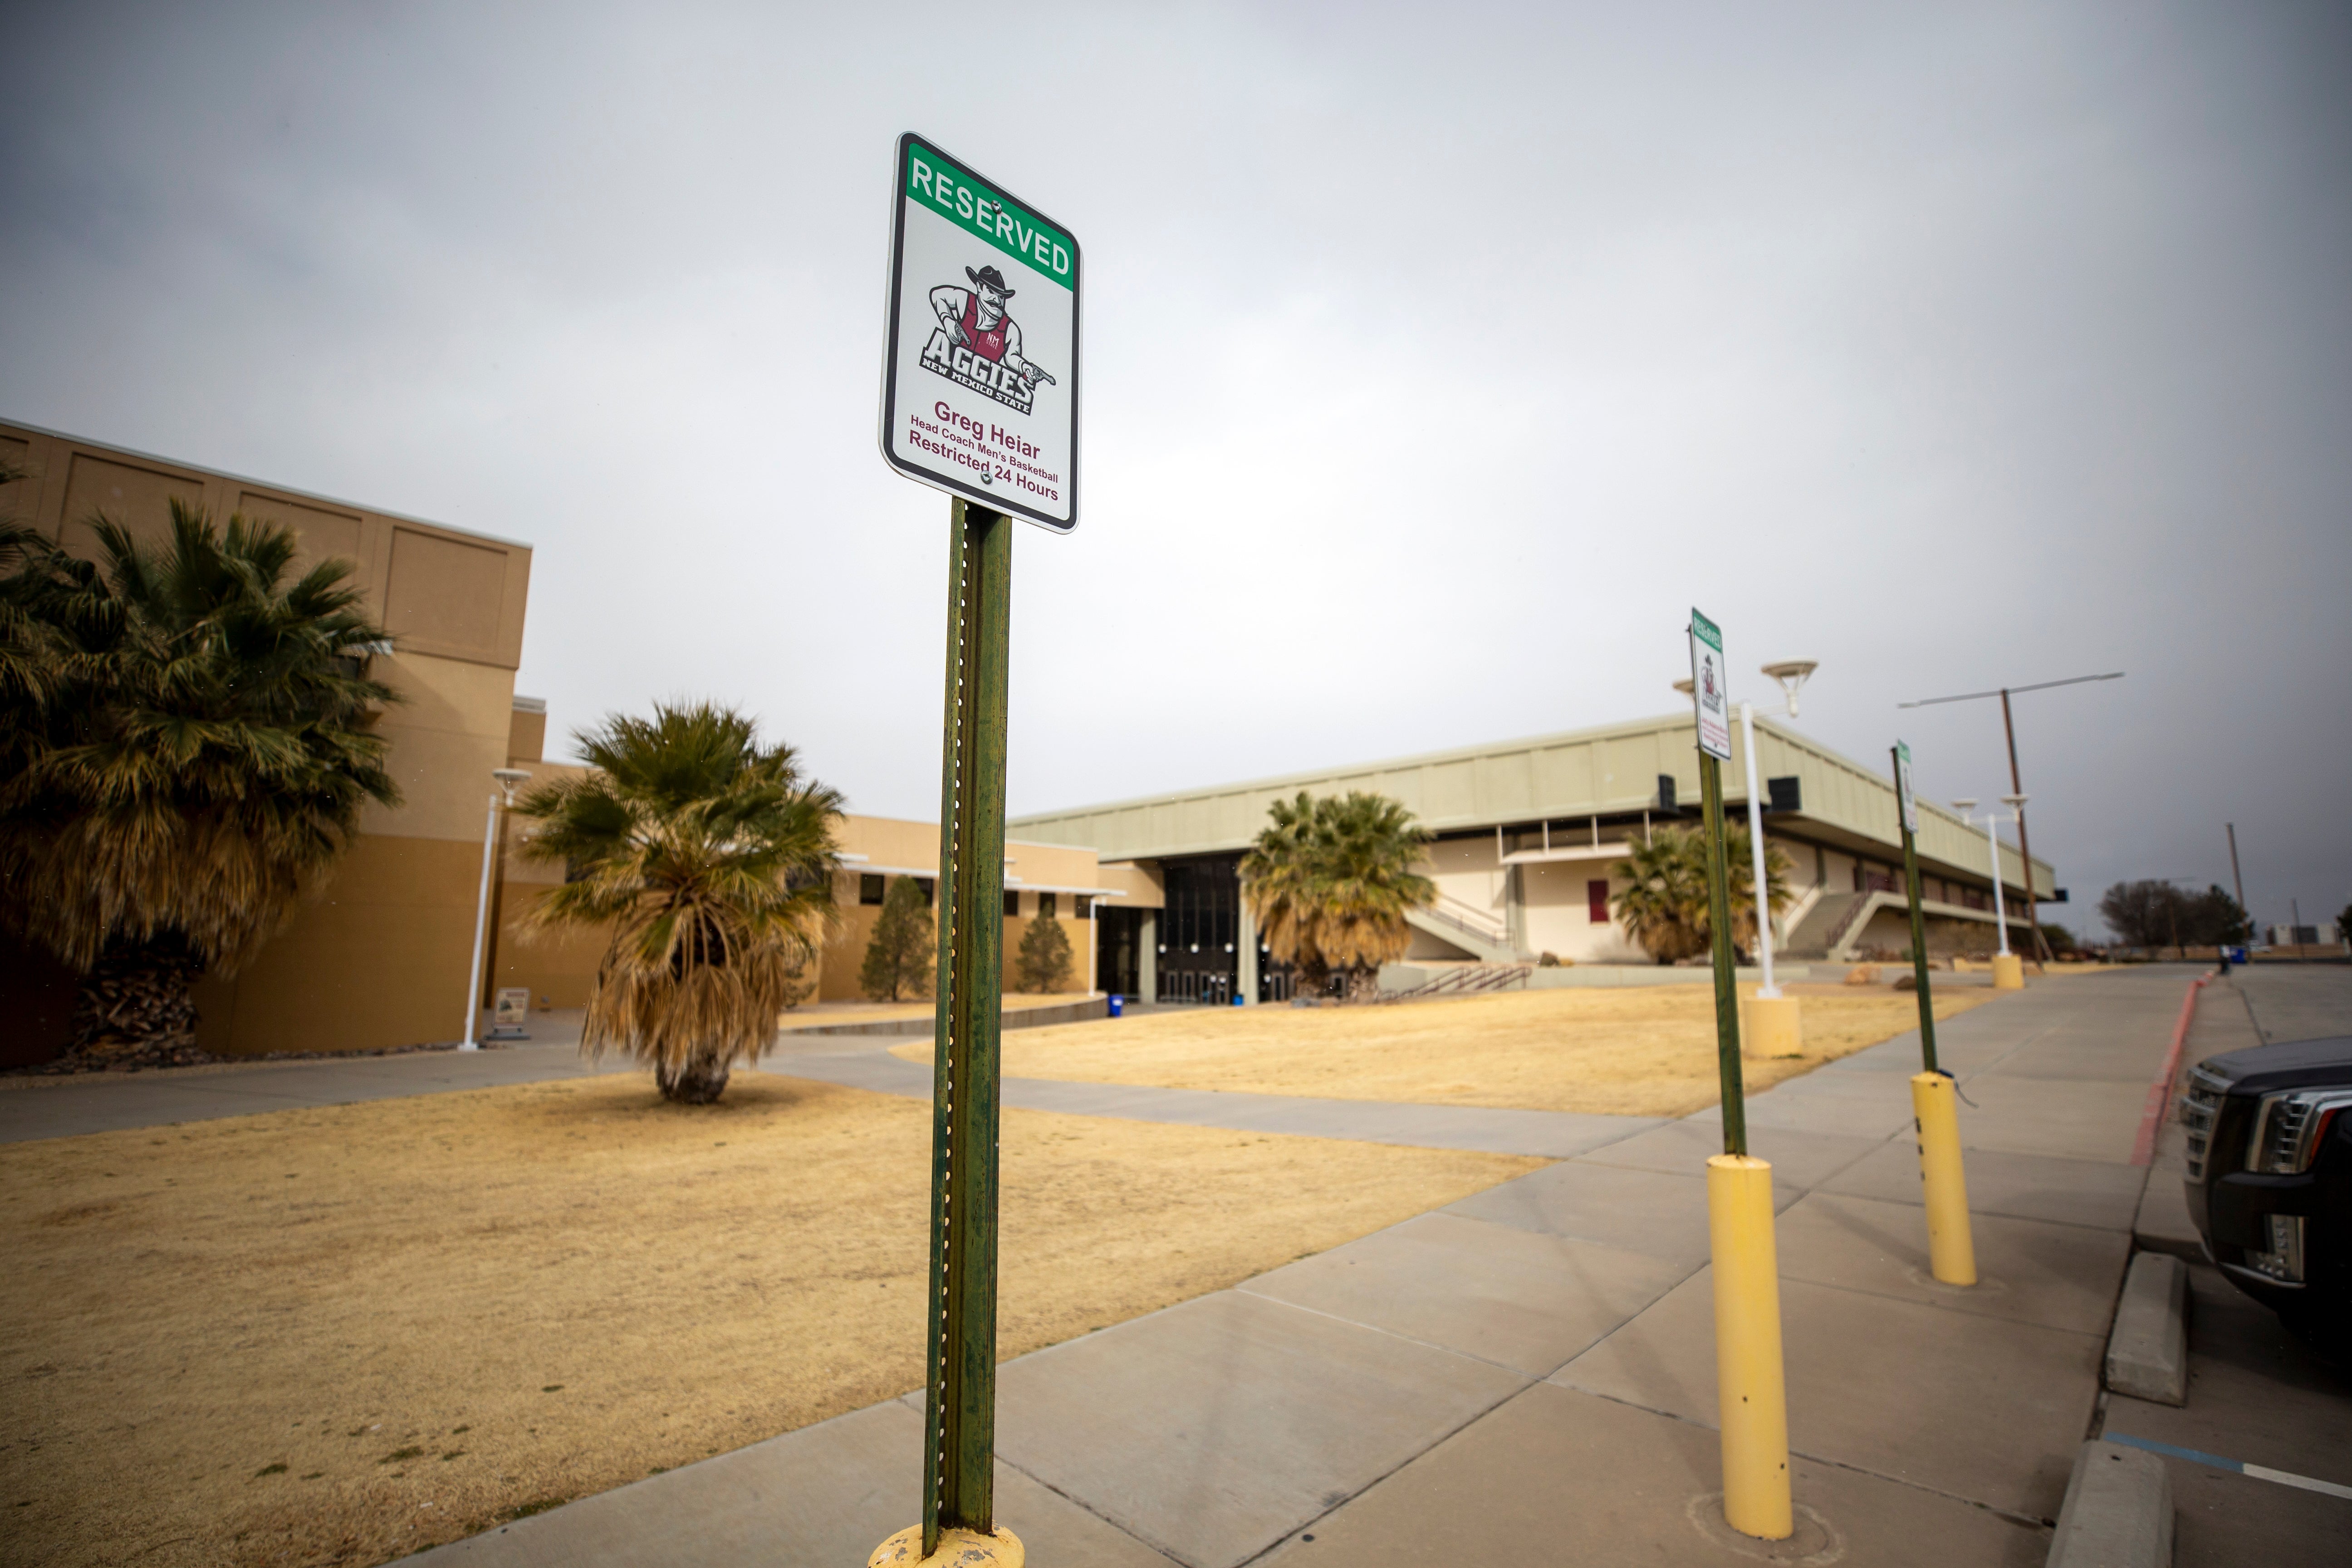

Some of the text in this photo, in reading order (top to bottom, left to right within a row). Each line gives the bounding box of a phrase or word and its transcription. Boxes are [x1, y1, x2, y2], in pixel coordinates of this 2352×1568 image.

[912, 157, 1069, 275] RESERVED
[924, 329, 1034, 403] AGGIES
[986, 340, 998, 350] STATE
[987, 332, 1000, 346] NM
[922, 358, 1030, 413] NEW MEXICO STATE
[911, 414, 938, 434] Head
[942, 428, 974, 450] Coach
[1009, 456, 1058, 483] Basketball
[935, 401, 1040, 460] Greg Heiar
[910, 429, 1058, 501] Restricted 24 Hours
[1694, 616, 1721, 647] RESERVED
